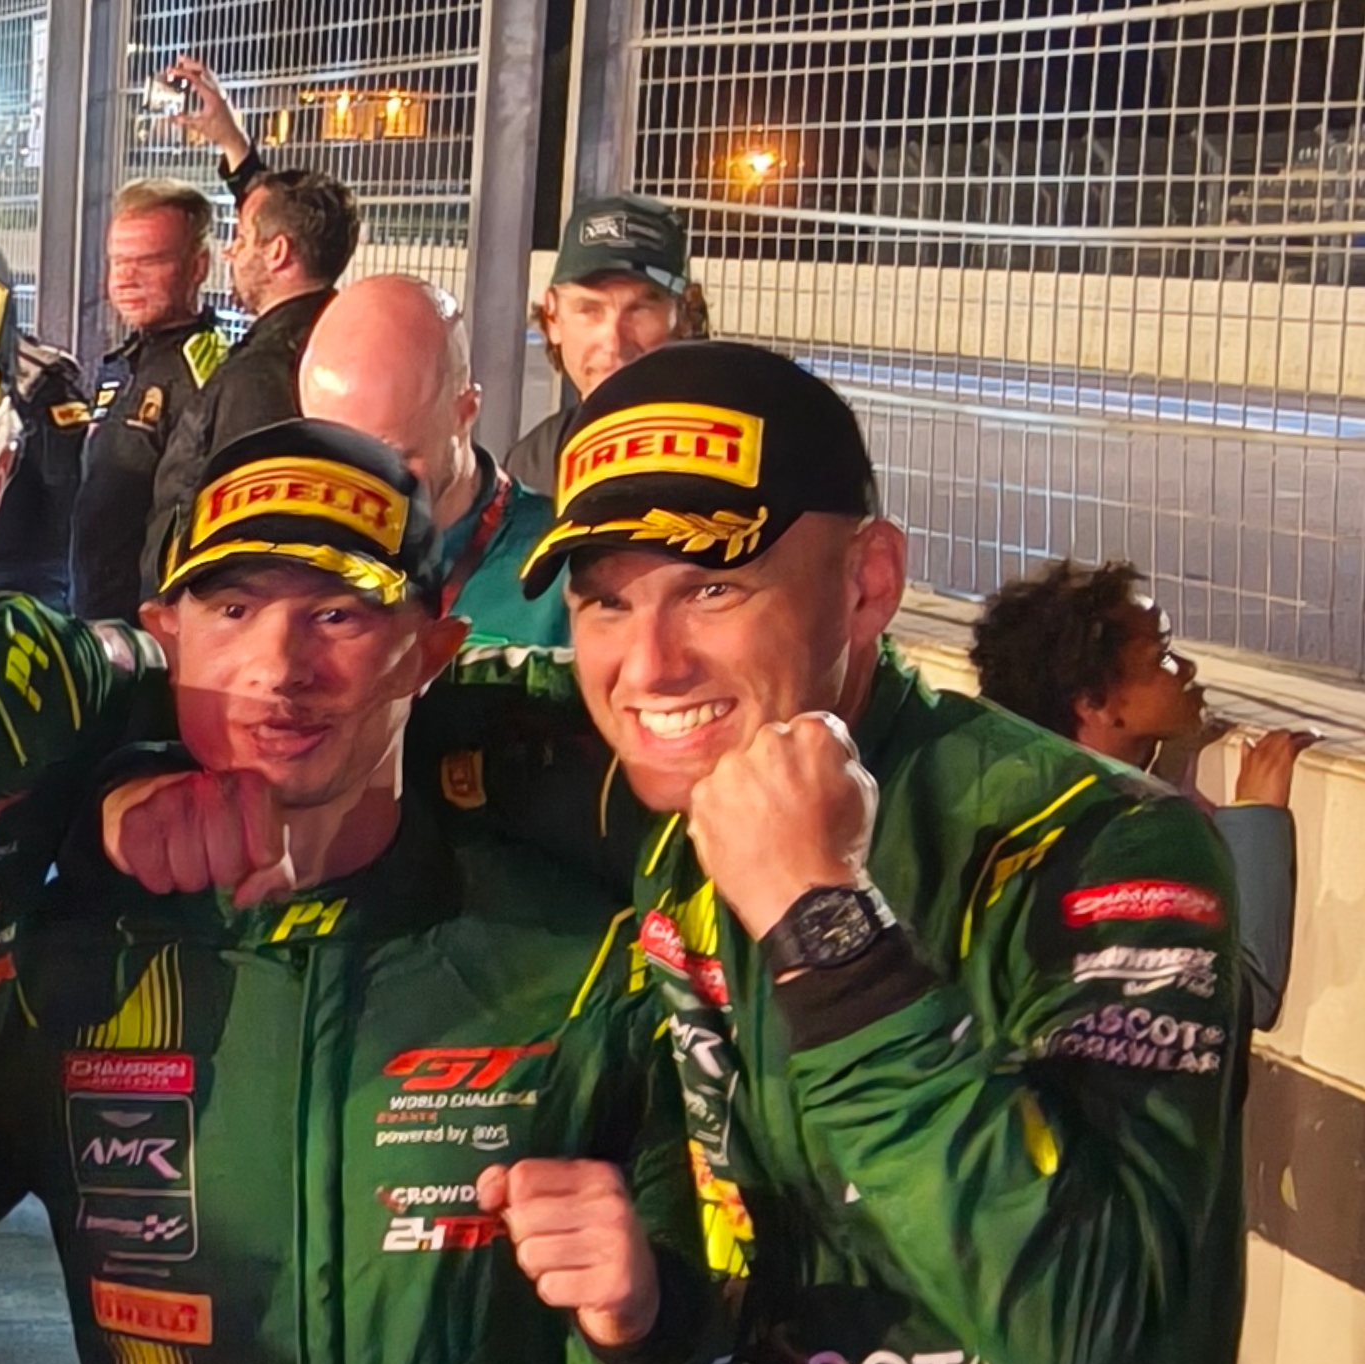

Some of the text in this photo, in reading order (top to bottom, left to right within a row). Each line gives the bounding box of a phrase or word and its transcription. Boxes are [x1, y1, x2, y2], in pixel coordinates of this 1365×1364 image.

[562, 418, 744, 490] PIRELLI
[203, 476, 392, 528] PIRELLI
[382, 1039, 557, 1091] GT
[80, 1137, 183, 1180] AMR
[376, 1124, 444, 1147] powered
[446, 1124, 468, 1145] by
